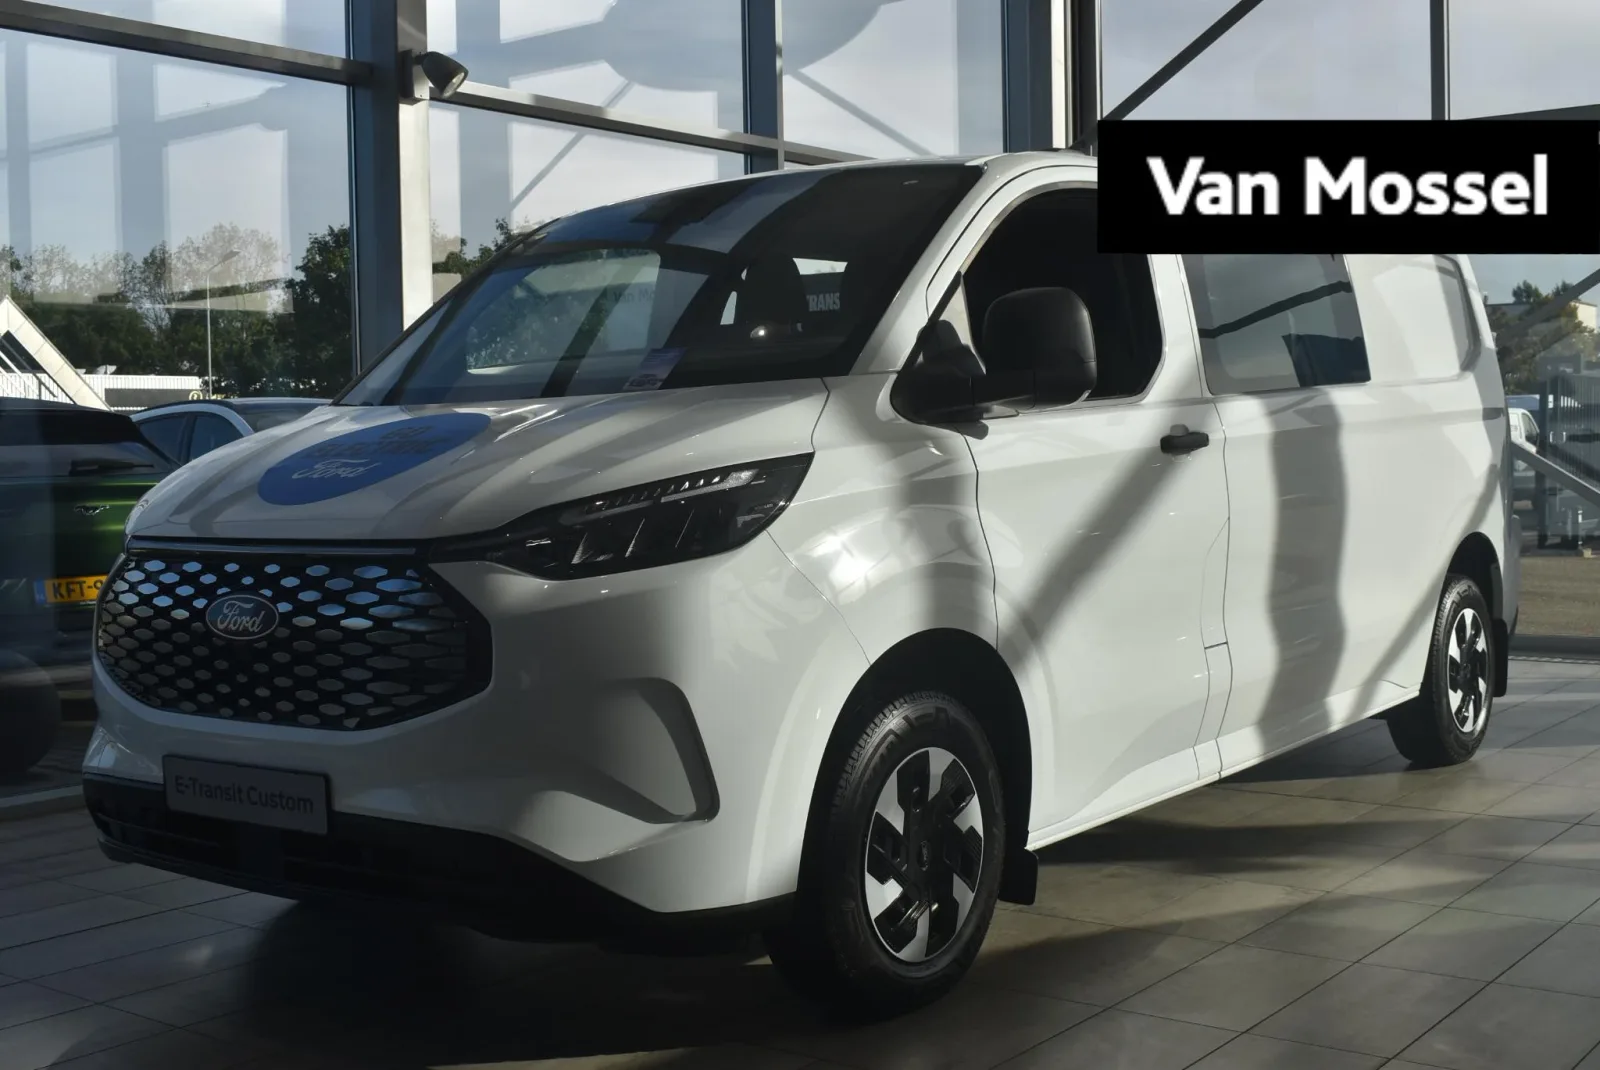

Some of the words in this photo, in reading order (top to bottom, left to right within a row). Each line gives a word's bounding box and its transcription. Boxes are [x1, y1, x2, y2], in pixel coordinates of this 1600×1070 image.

[806, 293, 841, 312] RANS
[291, 458, 382, 479] Ford
[217, 600, 266, 633] Ford
[174, 774, 244, 804] E-Transit
[246, 785, 314, 815] Custom
